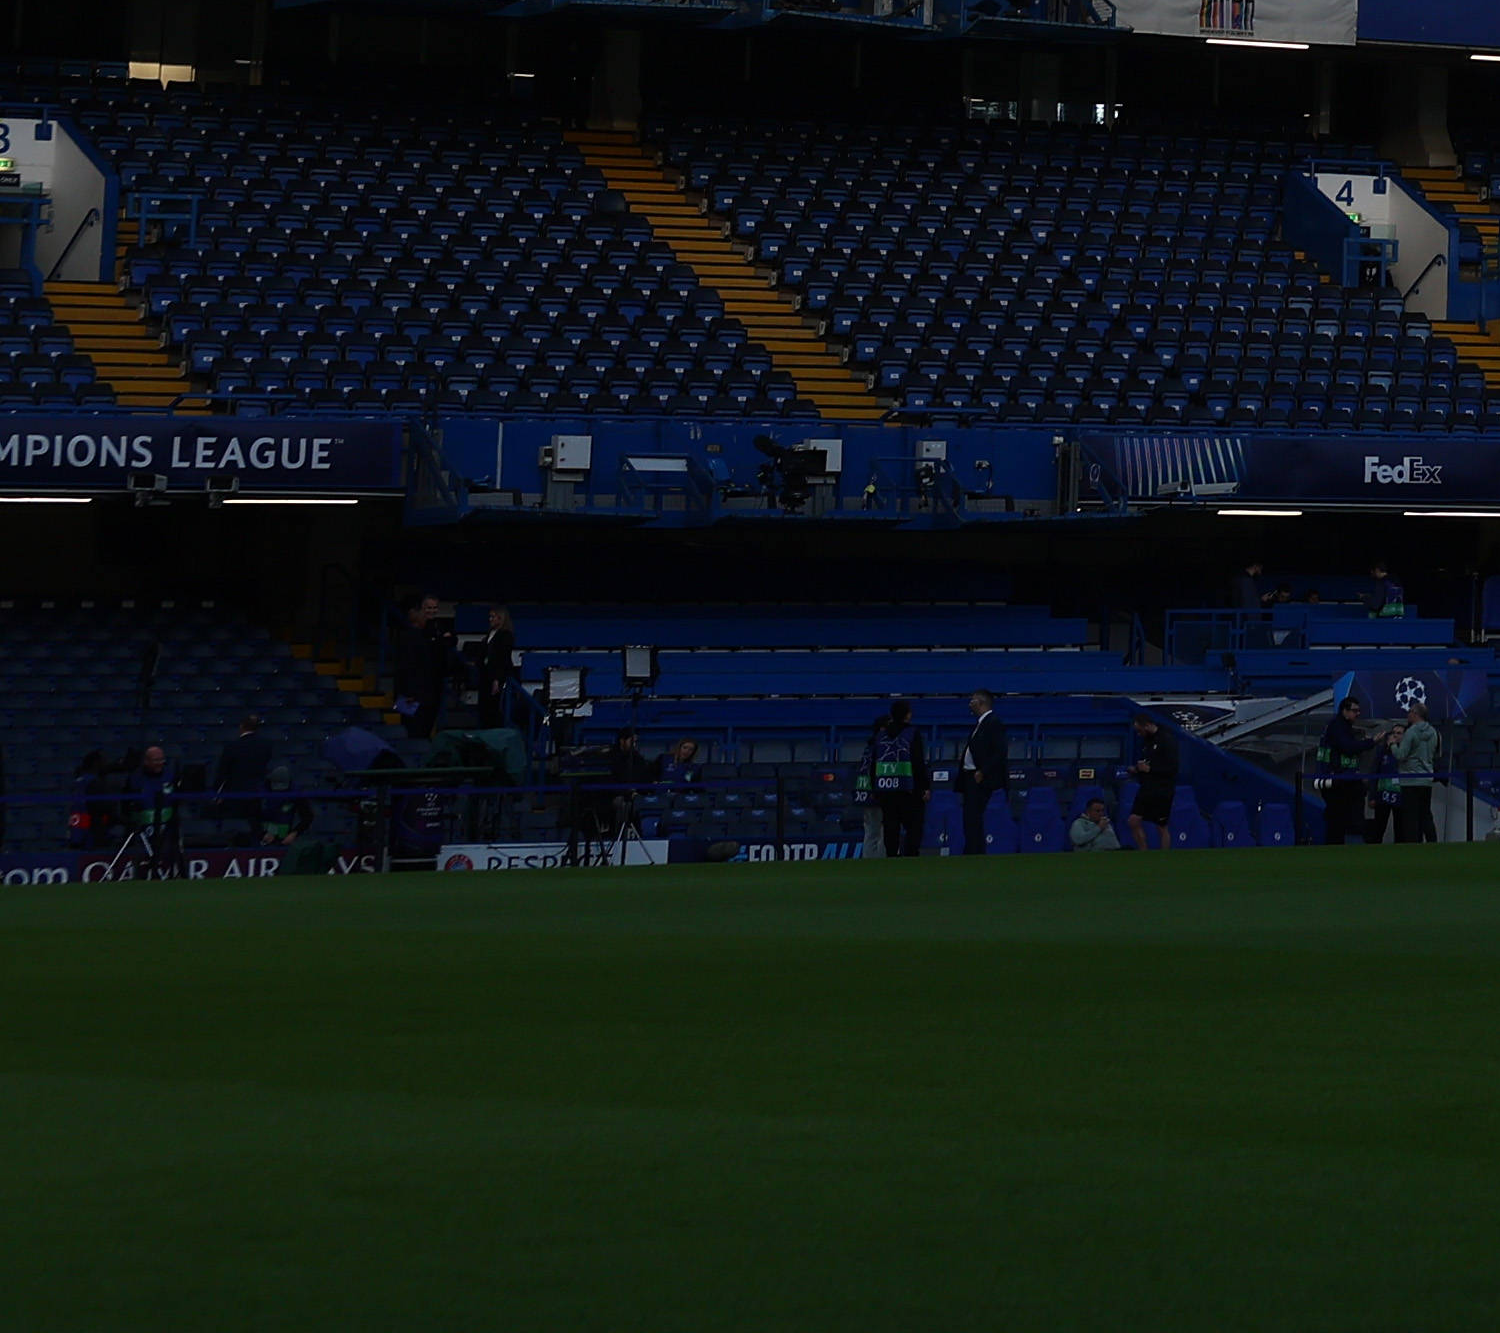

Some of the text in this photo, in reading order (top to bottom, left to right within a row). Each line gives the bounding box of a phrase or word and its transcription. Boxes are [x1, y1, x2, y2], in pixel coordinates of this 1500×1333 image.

[1336, 180, 1353, 206] 4
[1364, 456, 1442, 484] FedEx
[223, 853, 376, 877] AIRYS
[487, 855, 612, 869] RESPEC
